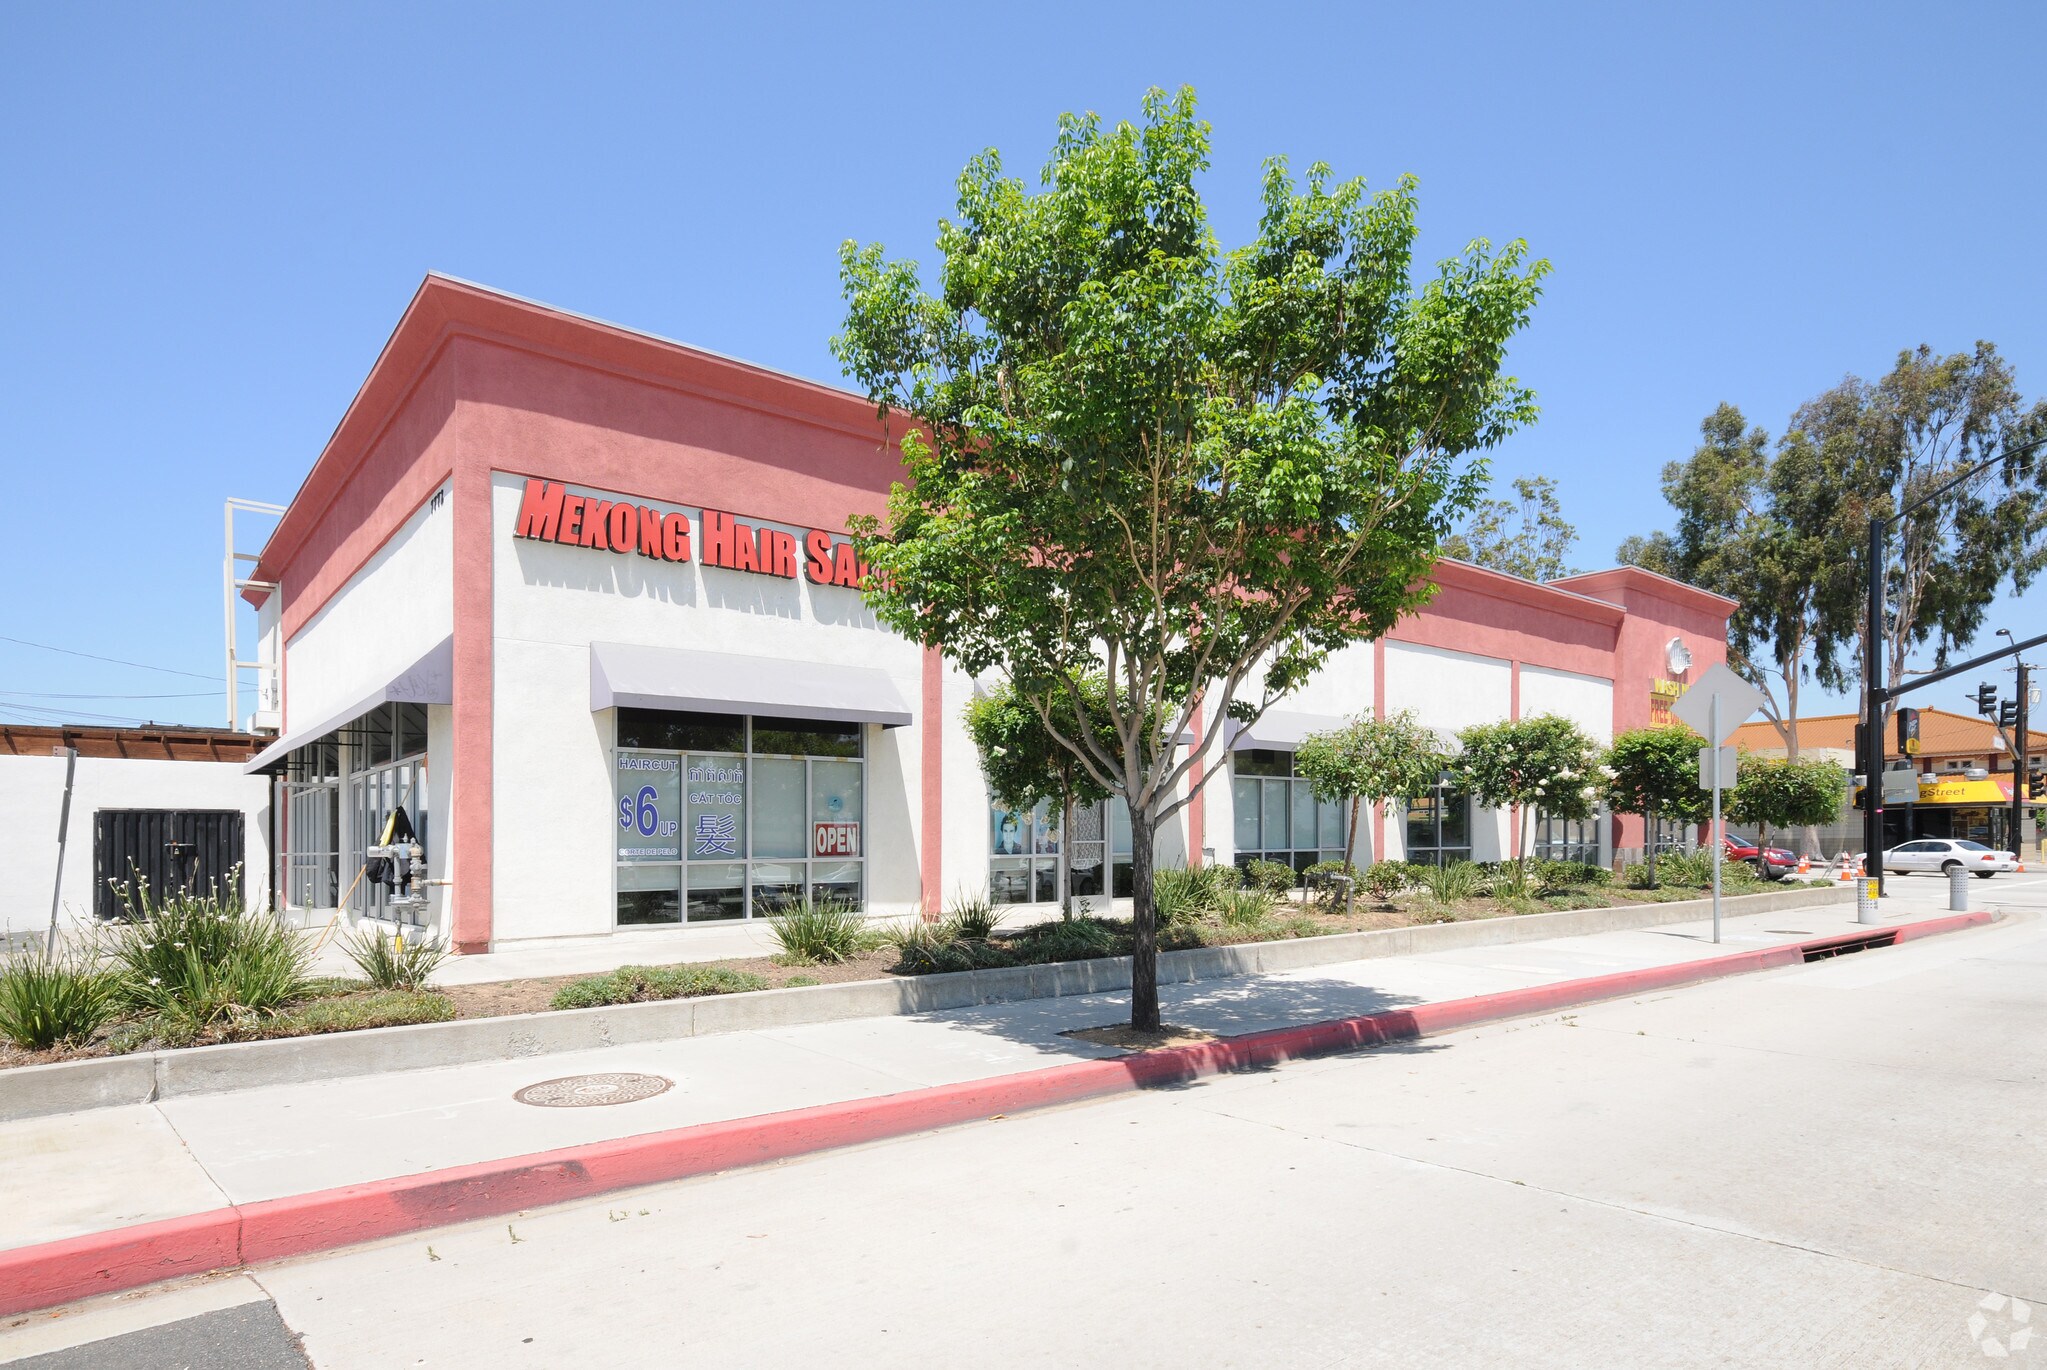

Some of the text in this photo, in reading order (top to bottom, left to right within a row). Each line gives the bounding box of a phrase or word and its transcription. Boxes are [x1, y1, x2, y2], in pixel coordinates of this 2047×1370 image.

[513, 479, 691, 563] MEKONG
[699, 509, 797, 579] HAIR
[619, 758, 678, 771] HAIRCUT
[1919, 787, 1966, 799] gStreet
[660, 821, 678, 837] UP
[816, 826, 857, 853] OPEN
